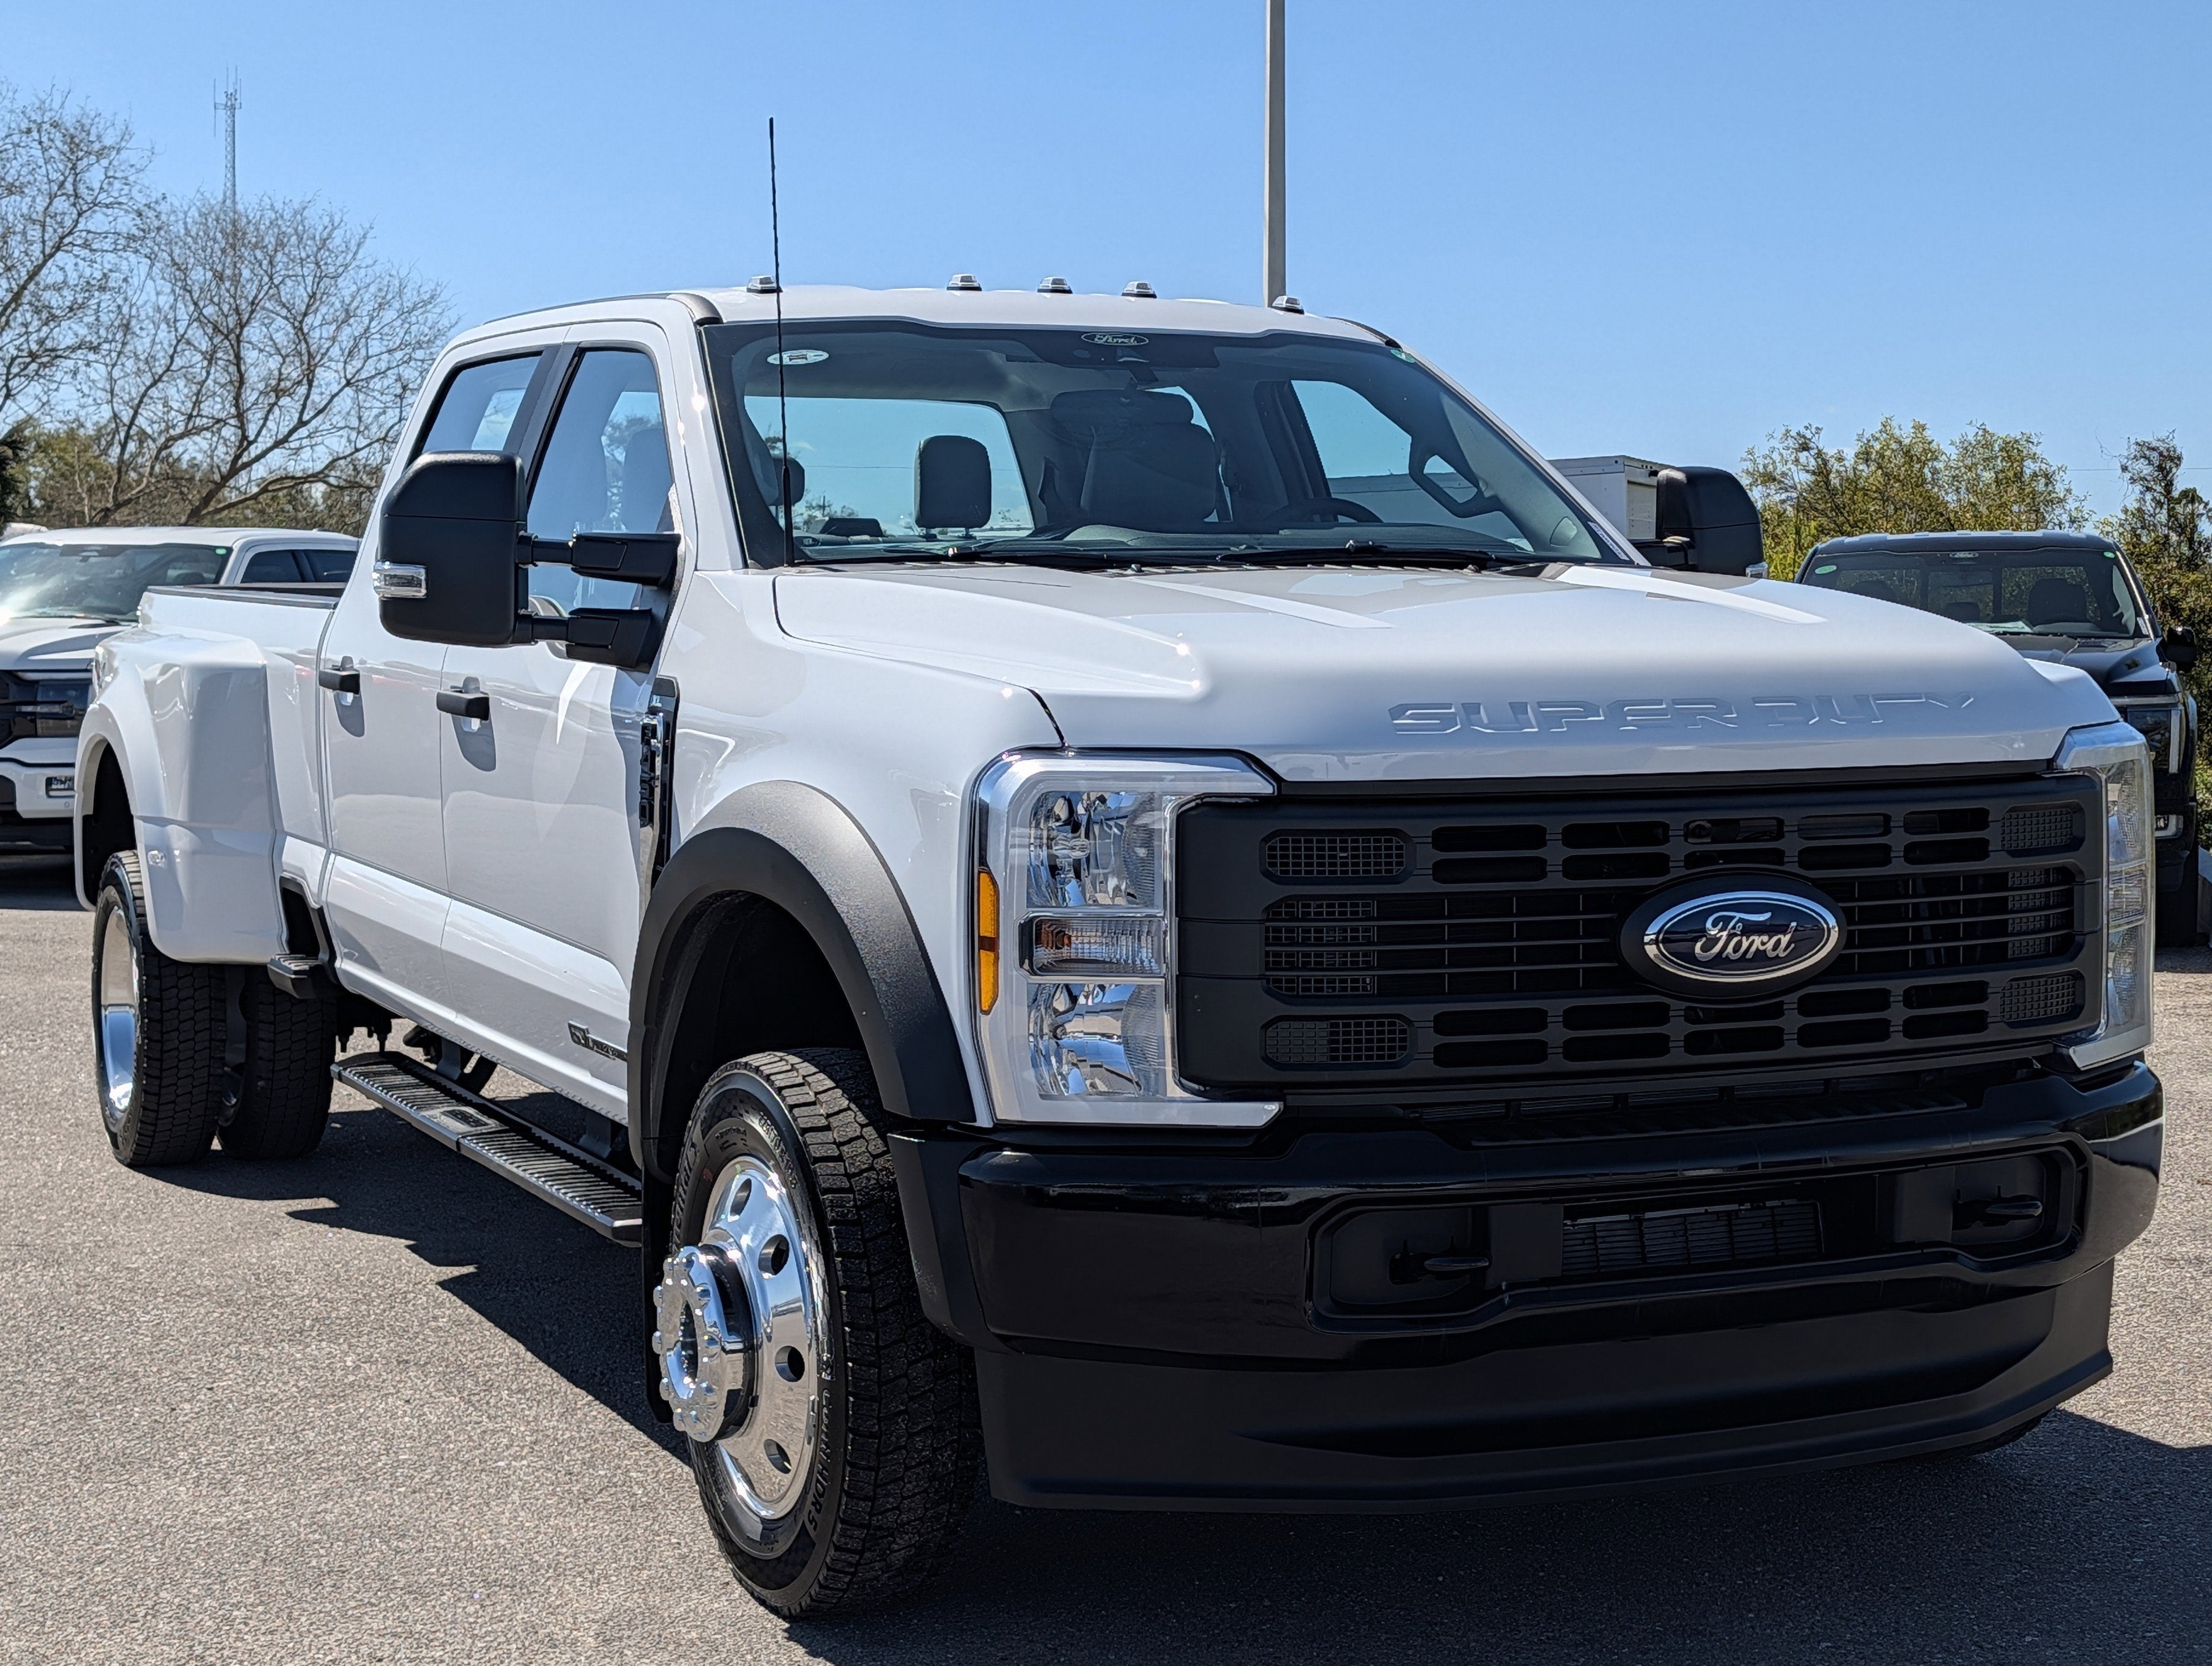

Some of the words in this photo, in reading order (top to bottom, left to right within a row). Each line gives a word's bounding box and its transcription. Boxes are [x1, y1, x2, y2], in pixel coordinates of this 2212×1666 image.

[1388, 699, 1739, 734] SUPER
[1751, 691, 1974, 727] DUTY
[1694, 911, 1798, 962] Ford
